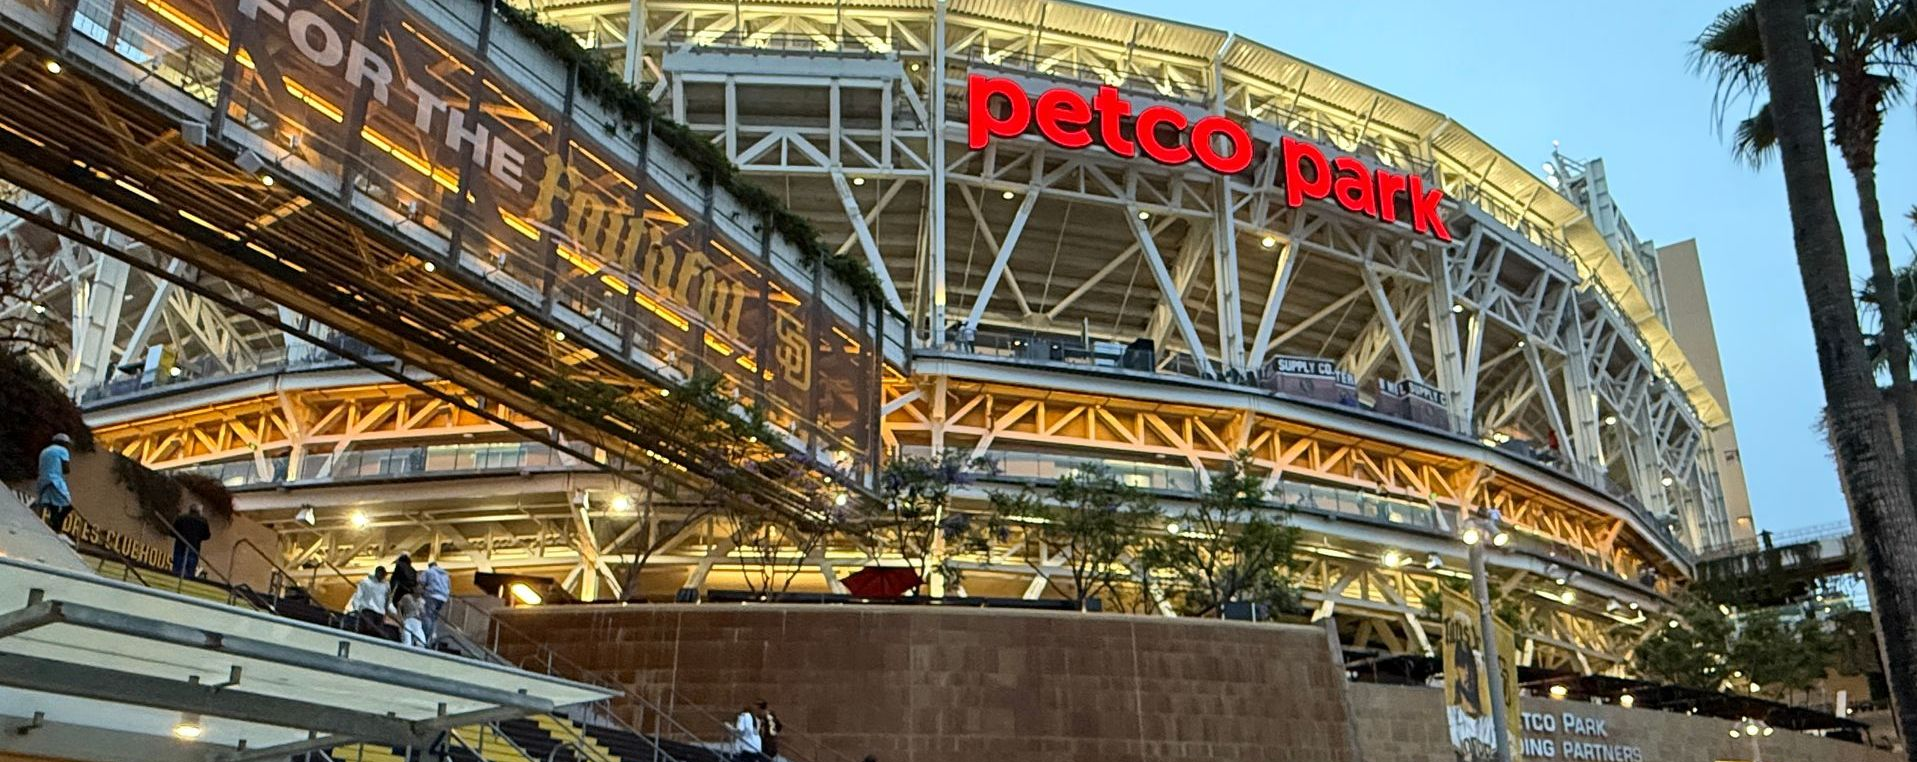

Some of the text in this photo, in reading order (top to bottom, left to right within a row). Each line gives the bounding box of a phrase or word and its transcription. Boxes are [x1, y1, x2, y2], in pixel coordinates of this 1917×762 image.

[406, 78, 525, 193] THE
[968, 73, 1452, 242] petco park
[1278, 359, 1315, 374] SUPPLY
[1409, 381, 1439, 402] SUPPLY
[105, 528, 173, 572] CLUBHOUS
[1520, 712, 1556, 732] TCO
[1562, 741, 1643, 762] PARTNERS
